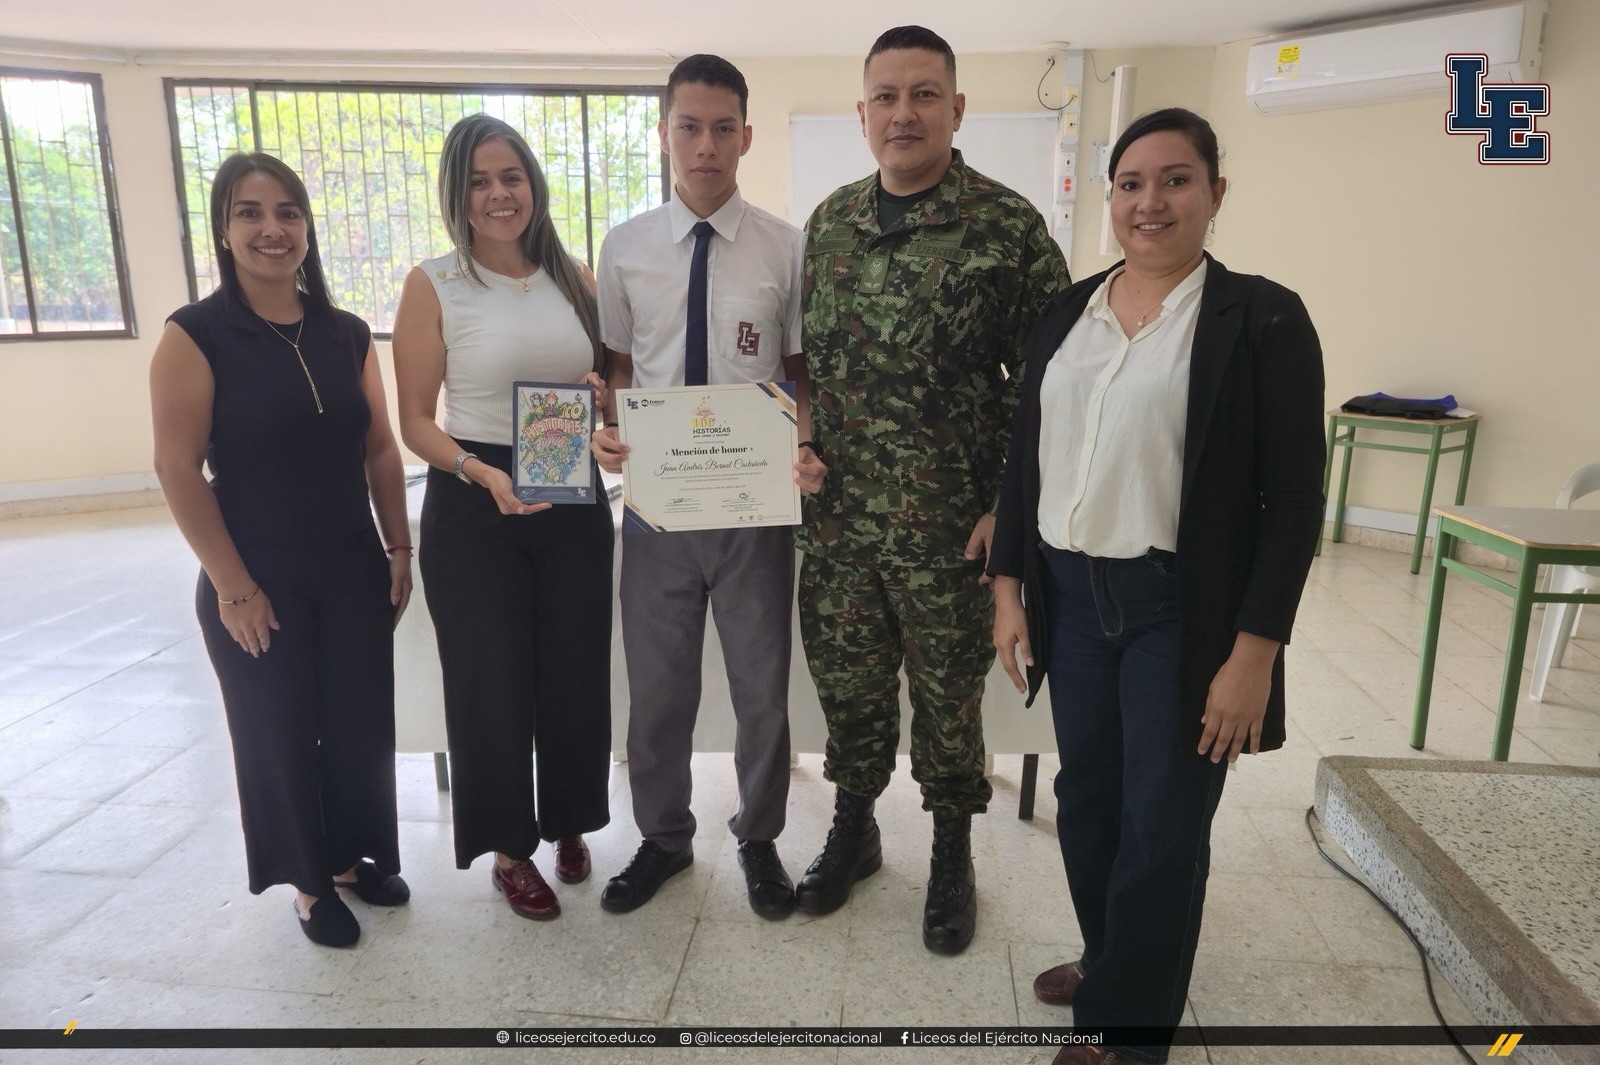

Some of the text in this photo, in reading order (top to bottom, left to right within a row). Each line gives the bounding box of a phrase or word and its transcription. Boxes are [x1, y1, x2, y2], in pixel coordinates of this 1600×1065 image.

[627, 398, 639, 410] LE
[522, 418, 583, 440] HISTORIAS
[671, 445, 748, 457] Mención de honor
[654, 462, 678, 476] Juan
[678, 460, 704, 471] Andrés
[733, 458, 768, 468] Castañeda
